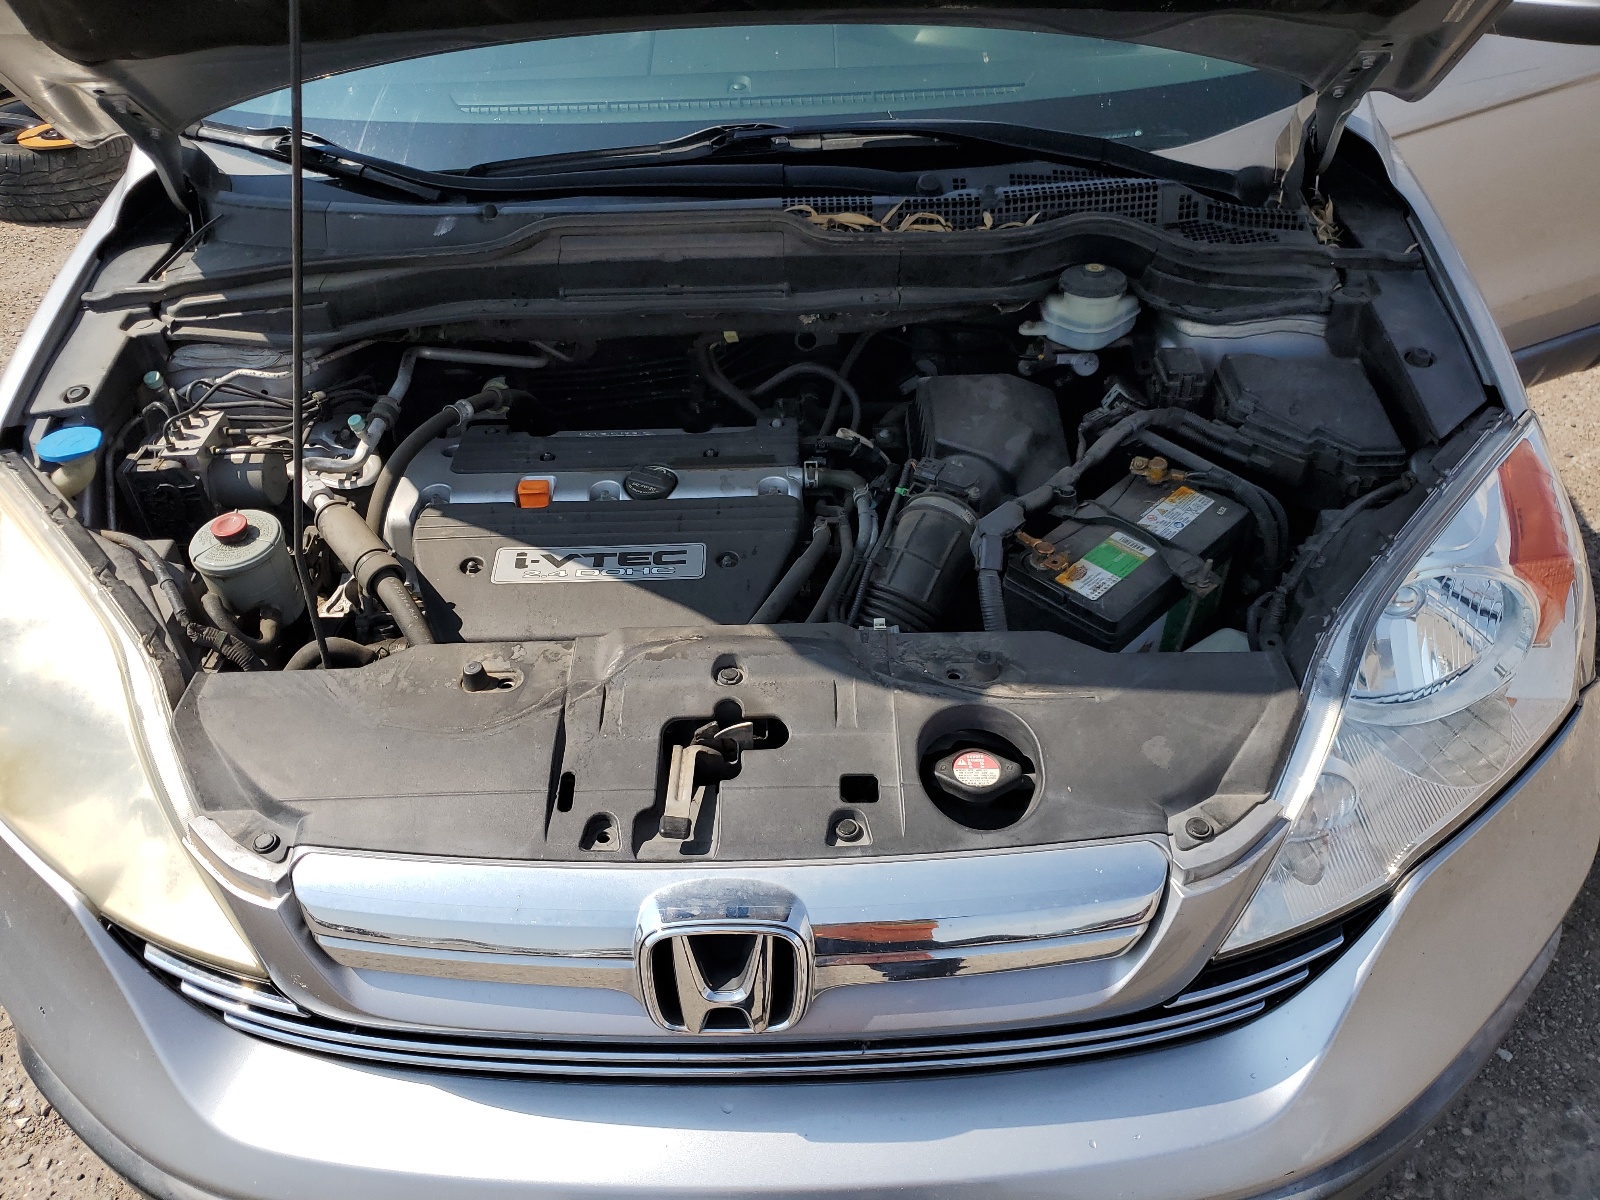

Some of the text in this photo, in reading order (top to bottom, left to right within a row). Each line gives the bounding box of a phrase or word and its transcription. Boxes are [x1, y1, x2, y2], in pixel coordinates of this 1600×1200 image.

[514, 549, 688, 569] i-VTEC
[521, 566, 677, 579] 2.4 DOHC
